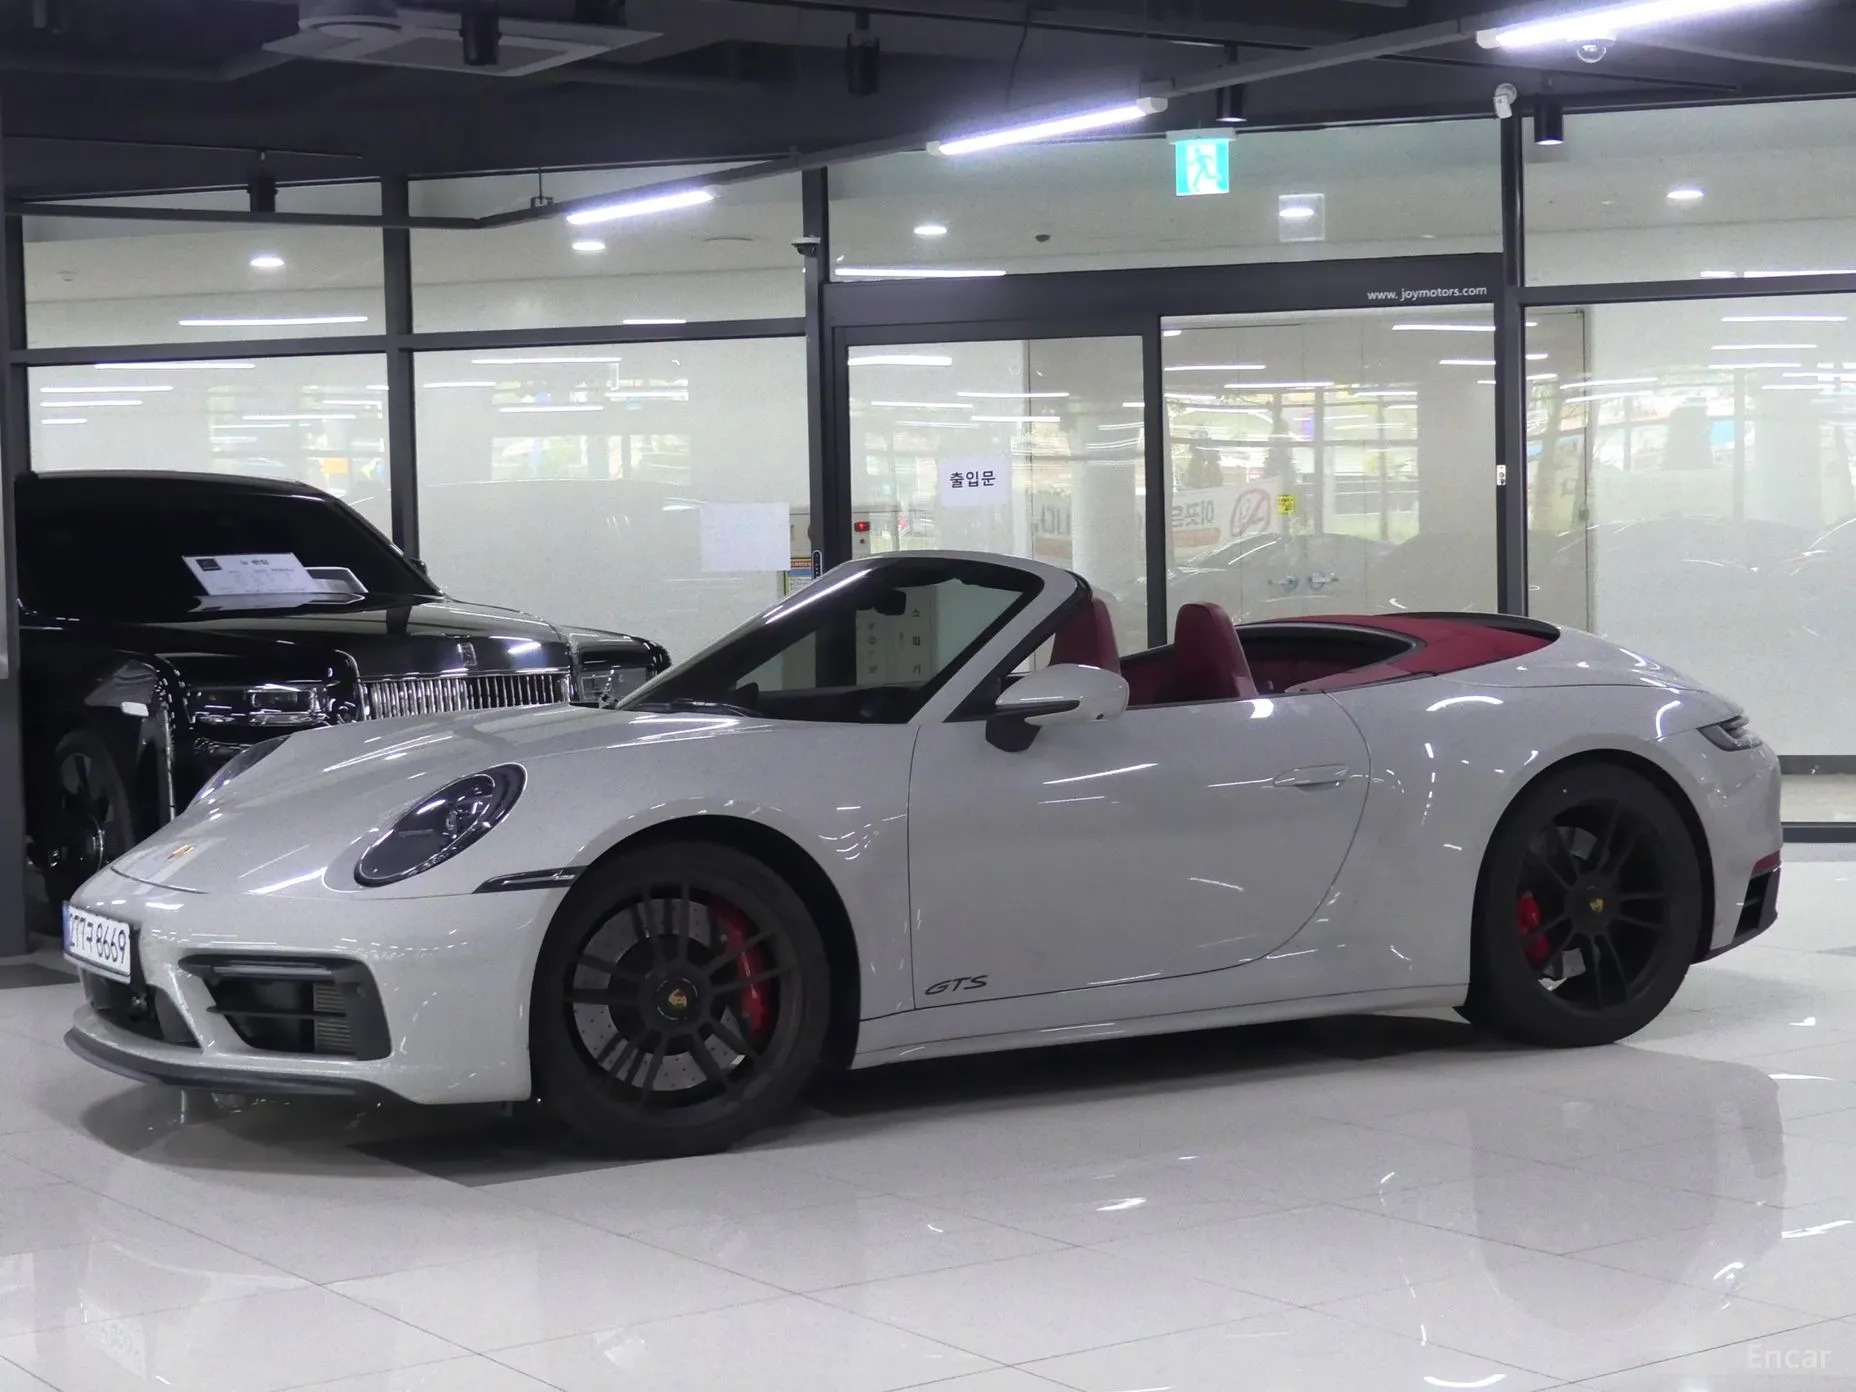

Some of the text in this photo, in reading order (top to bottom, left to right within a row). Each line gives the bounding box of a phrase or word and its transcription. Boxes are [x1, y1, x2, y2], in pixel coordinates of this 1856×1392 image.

[1367, 287, 1487, 301] www. joymotors.com
[950, 470, 996, 489] 출입문
[925, 974, 988, 995] GTS
